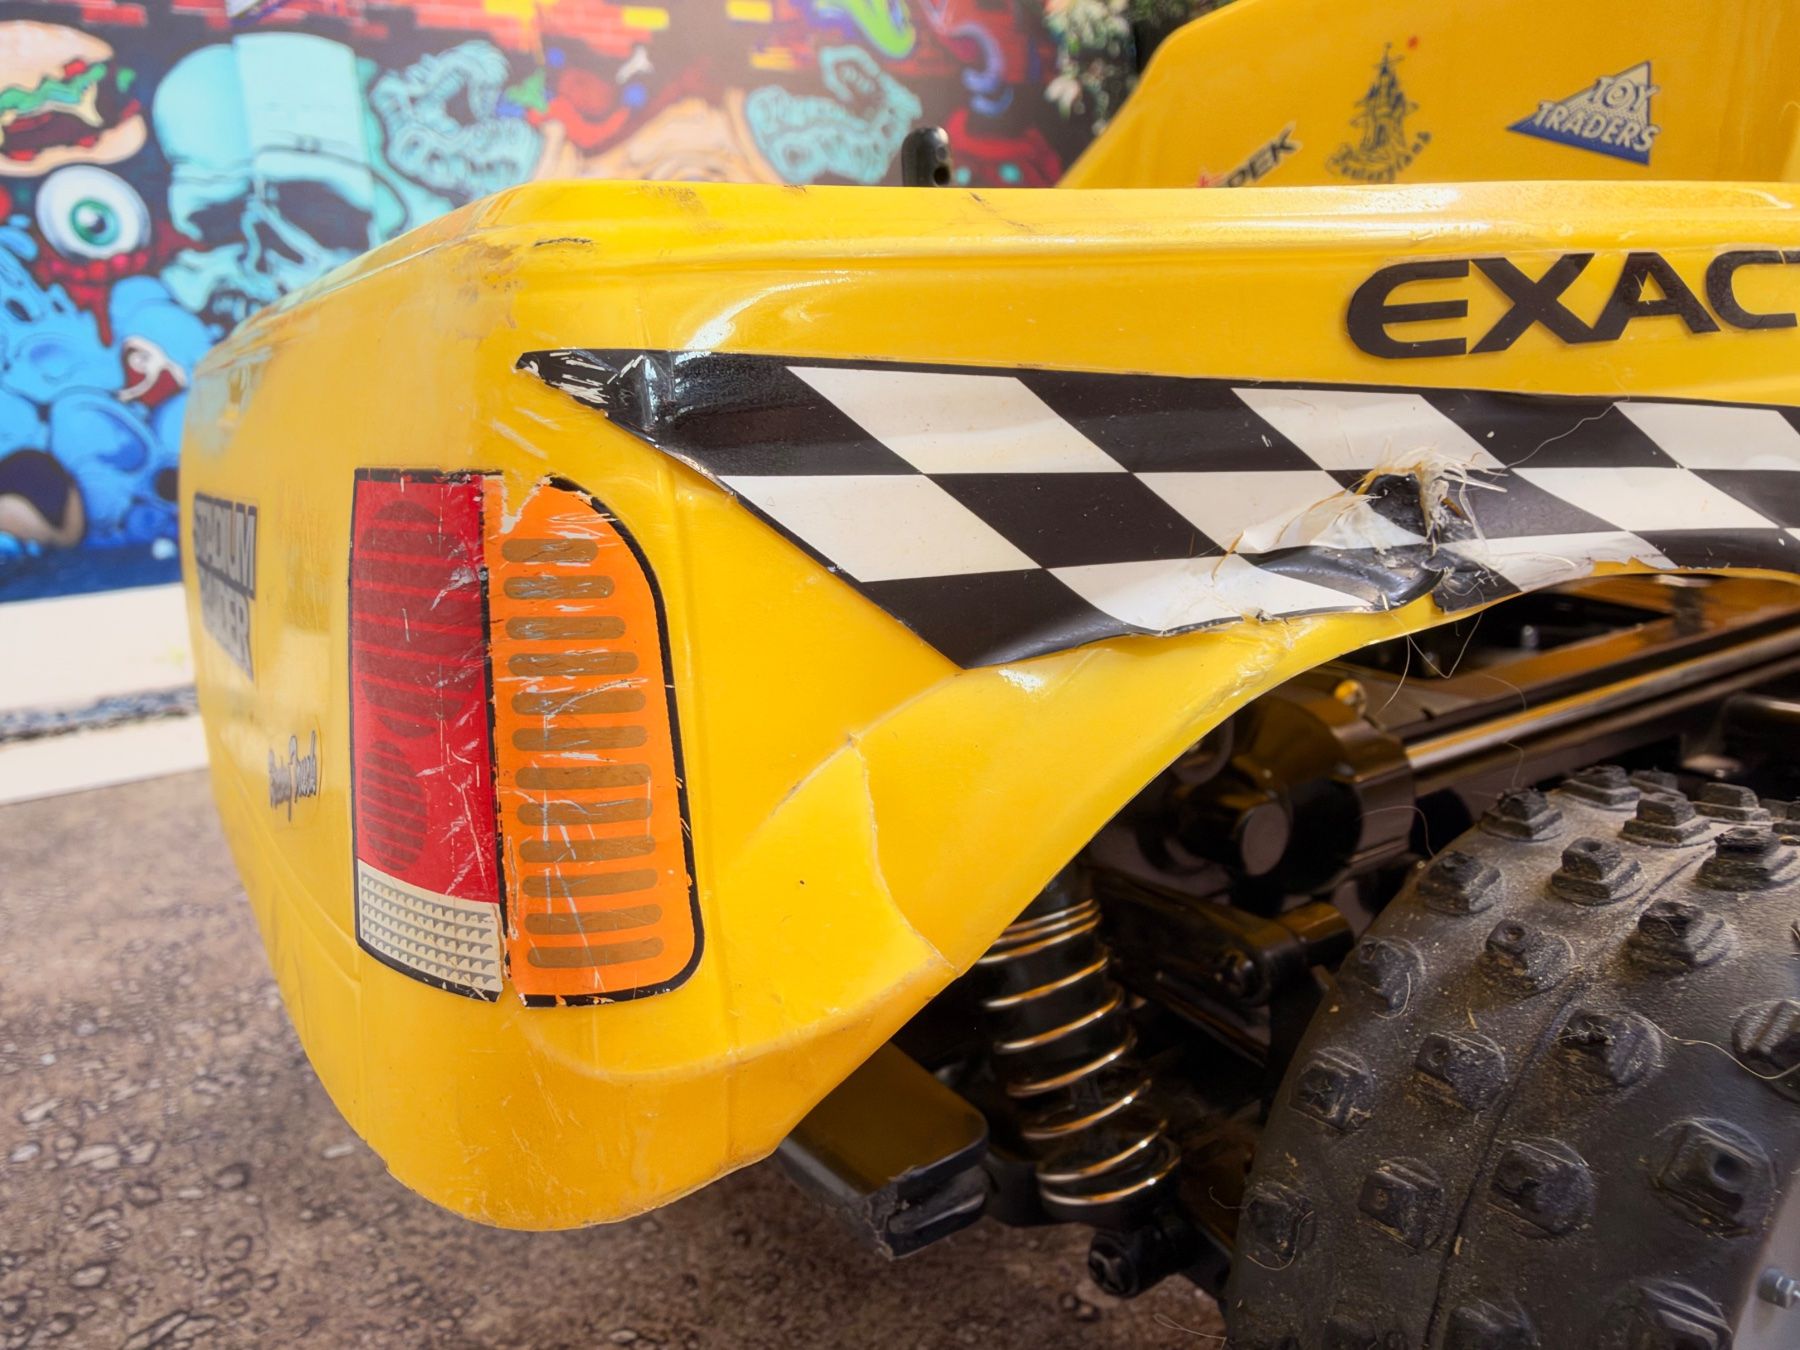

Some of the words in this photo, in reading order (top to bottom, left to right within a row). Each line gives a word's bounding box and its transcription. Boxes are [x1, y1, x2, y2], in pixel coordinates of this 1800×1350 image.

[1588, 76, 1660, 112] TOY
[1533, 102, 1662, 153] TRADERS
[1346, 249, 1800, 359] EXAC
